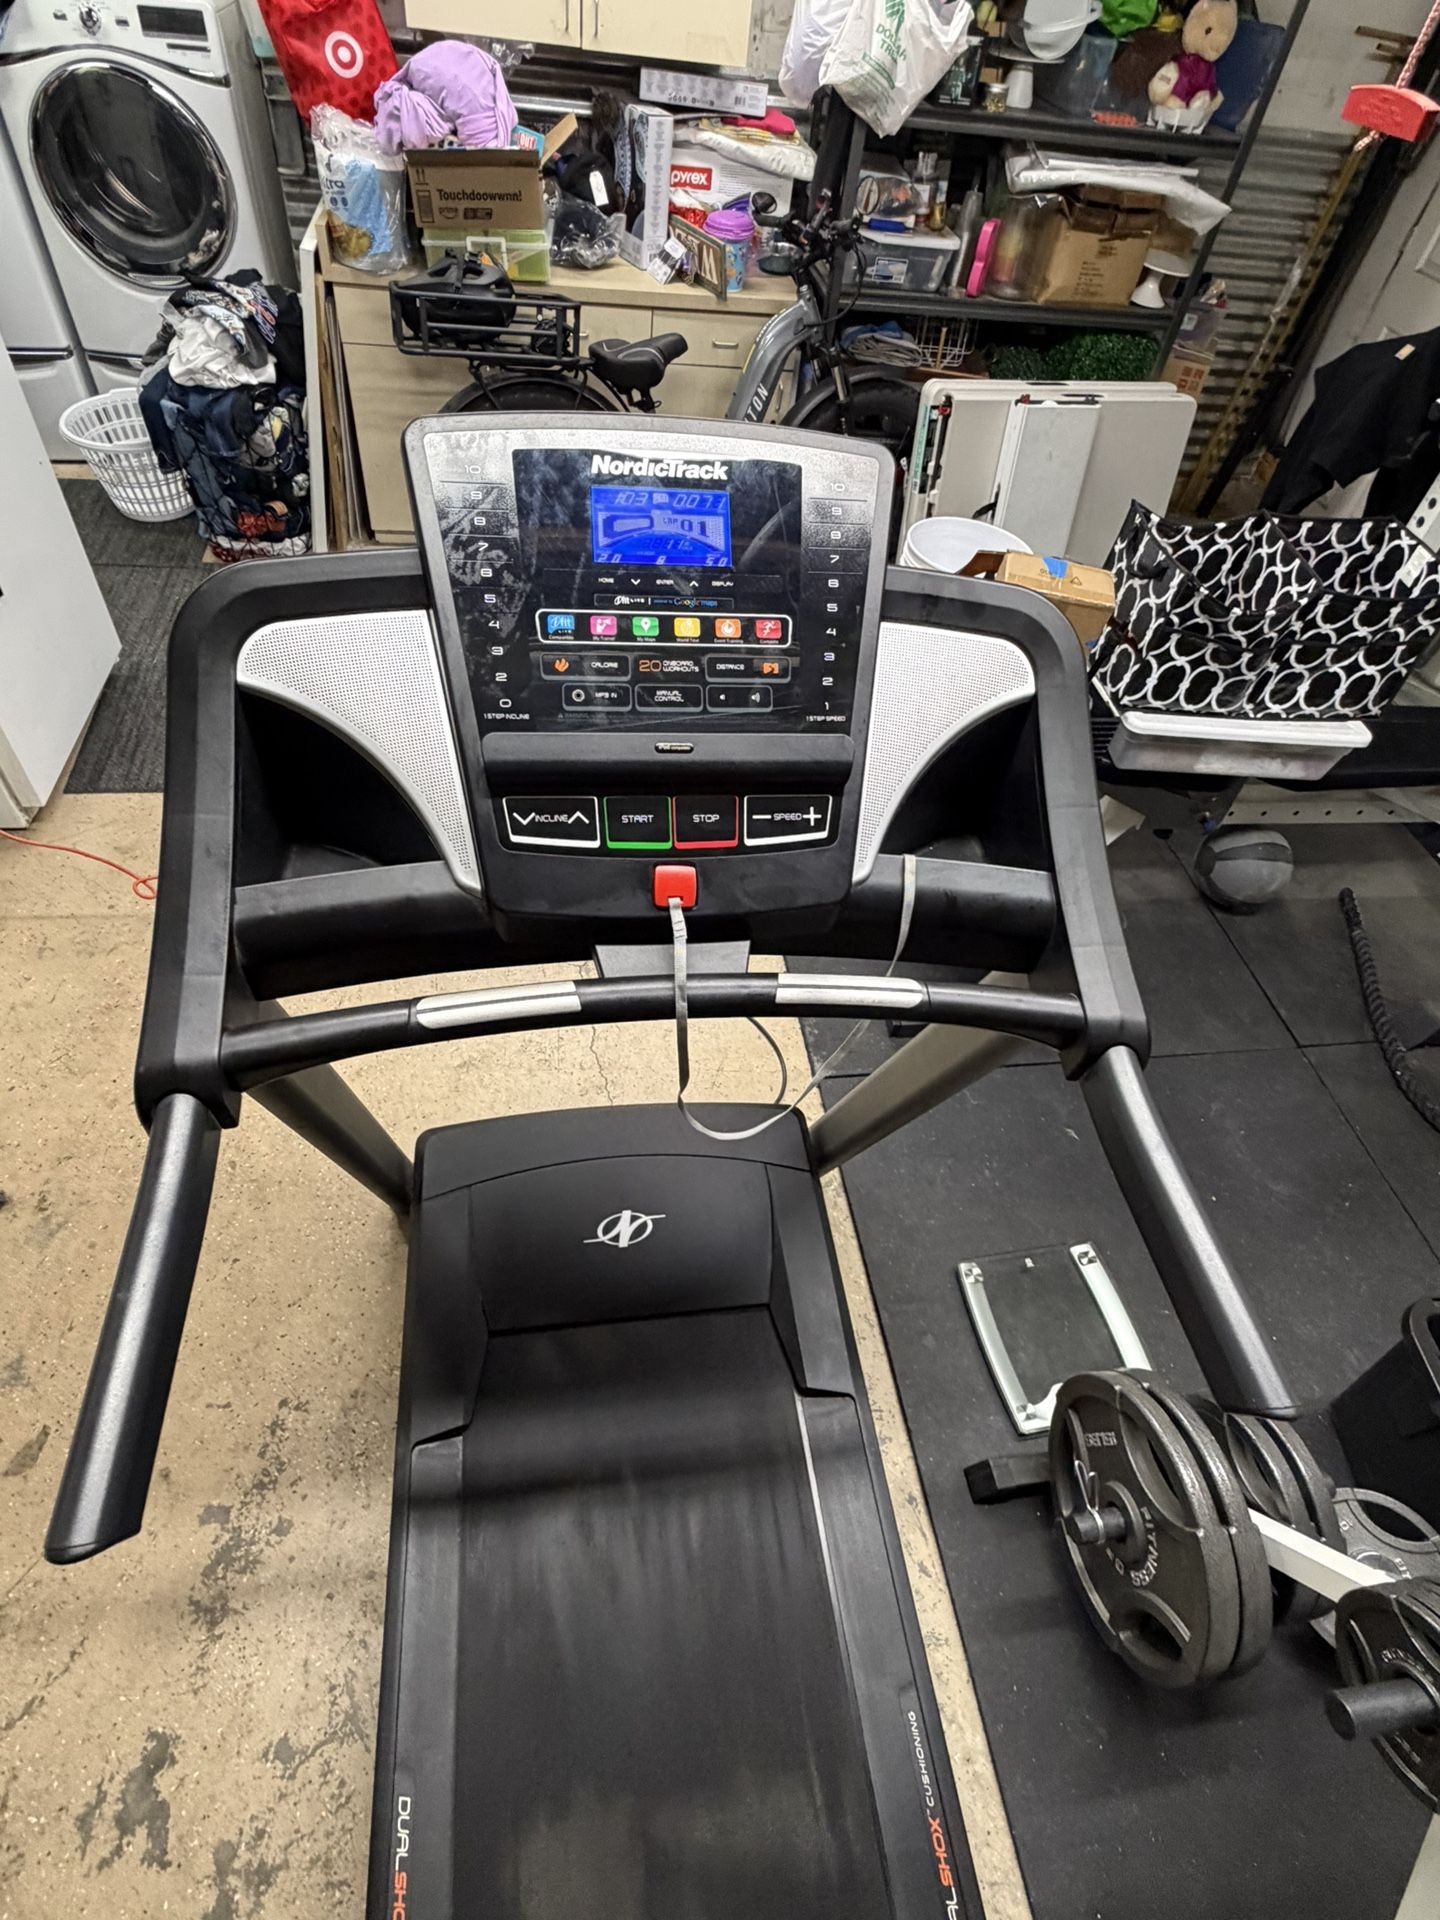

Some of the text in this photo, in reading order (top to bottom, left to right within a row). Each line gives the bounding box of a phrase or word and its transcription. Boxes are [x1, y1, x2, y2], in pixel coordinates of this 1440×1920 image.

[671, 170, 708, 186] pyrex
[436, 189, 523, 203] Touchdoowwnn!
[464, 465, 481, 474] 10
[591, 454, 729, 481] NordicTrack
[830, 483, 845, 492] 10
[474, 517, 486, 526] 8
[478, 542, 489, 551] 7
[829, 554, 840, 564] 7
[484, 594, 496, 603] 5
[826, 603, 838, 612] 5
[488, 620, 500, 630] 4
[826, 627, 837, 637] 4
[491, 646, 504, 656] 3
[823, 652, 835, 661] 3
[639, 659, 662, 672] 20
[495, 672, 508, 682] 2
[822, 677, 833, 686] 2
[656, 689, 682, 697] MANUAL
[824, 701, 830, 710] 1
[621, 814, 653, 824] START
[692, 814, 720, 823] STOP
[773, 812, 802, 822] SPEED
[908, 1710, 935, 1808] CUSHIONING
